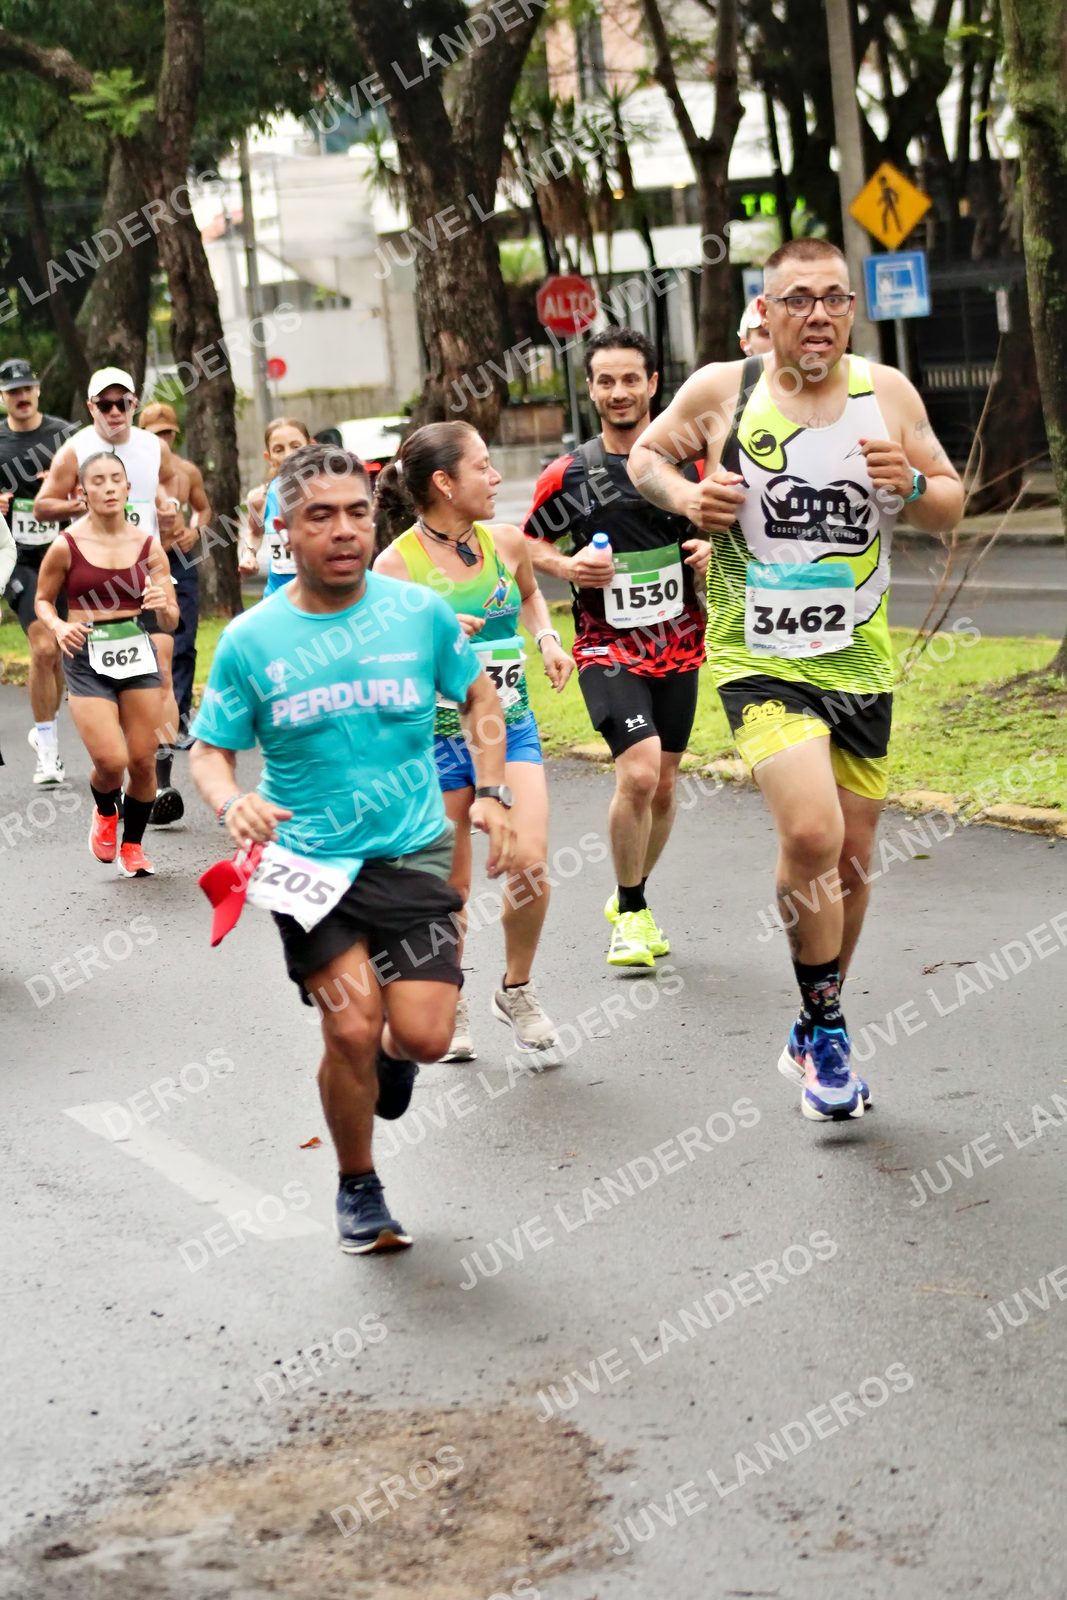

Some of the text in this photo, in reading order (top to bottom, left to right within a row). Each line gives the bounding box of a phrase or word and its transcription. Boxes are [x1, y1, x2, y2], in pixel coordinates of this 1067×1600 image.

[544, 291, 593, 320] ALTO
[790, 497, 846, 513] RINOS
[612, 578, 678, 610] 1530
[753, 604, 846, 635] 3462
[102, 646, 142, 667] 662
[271, 678, 421, 727] PERDURA
